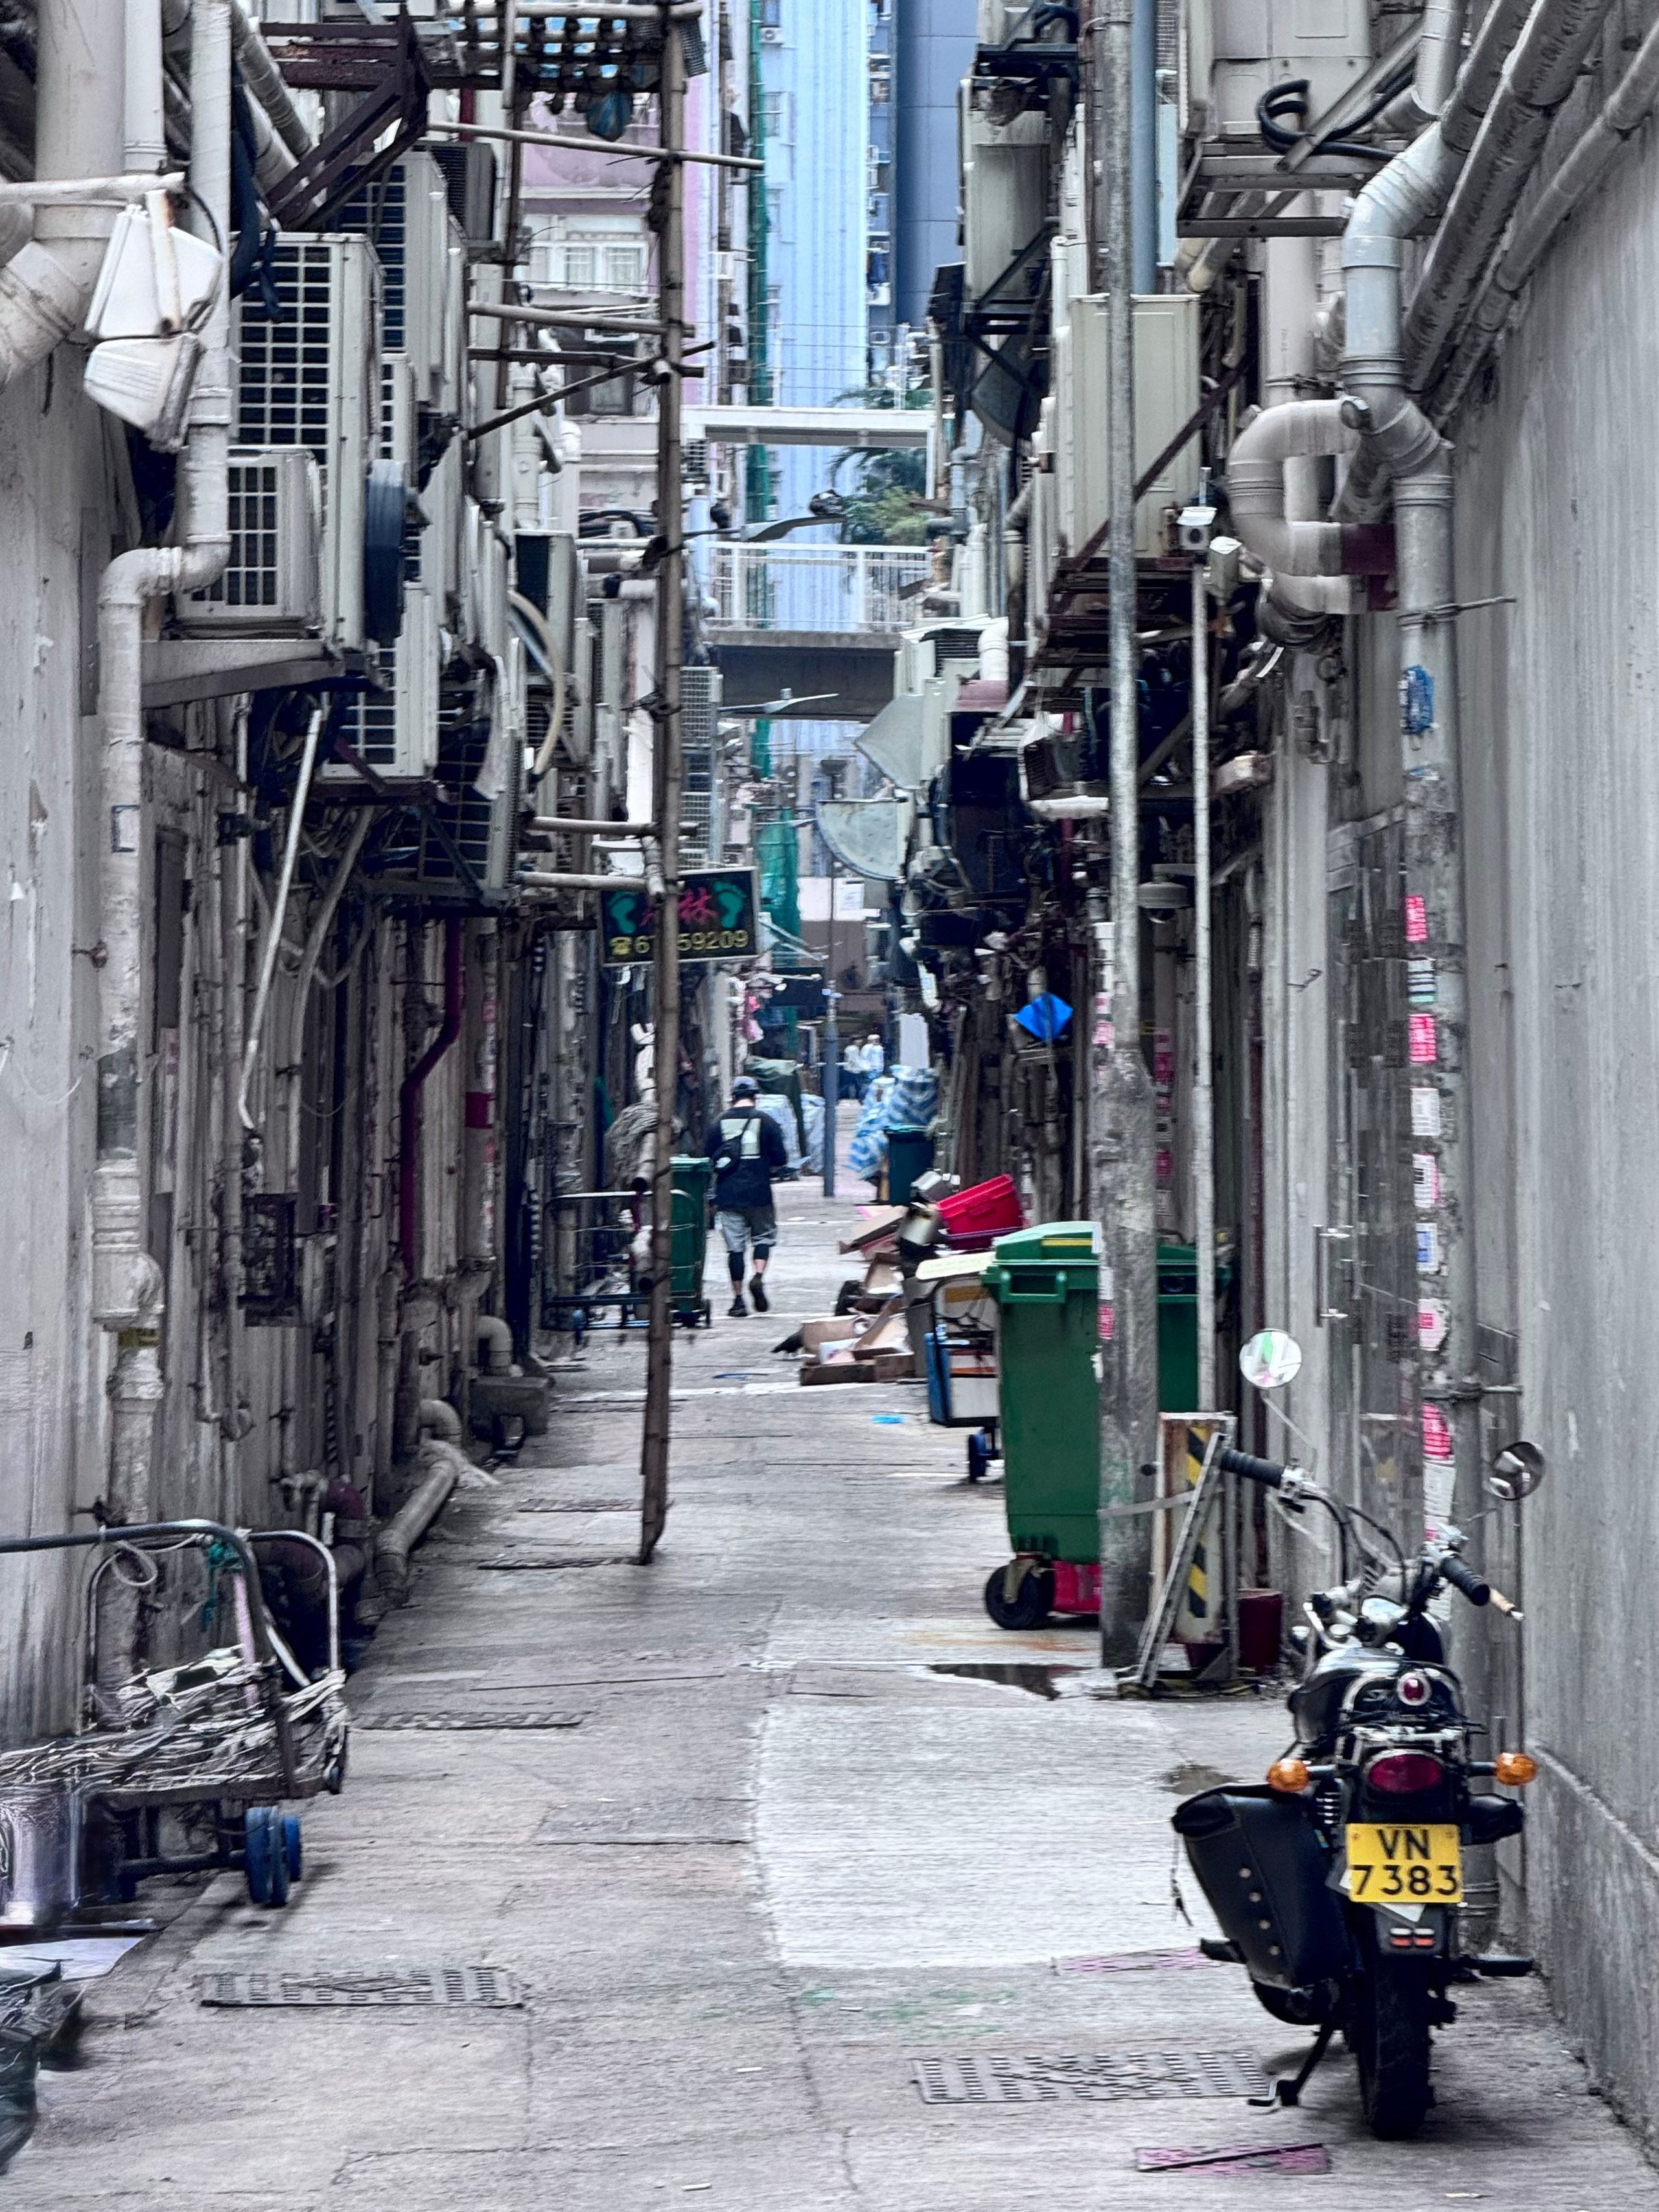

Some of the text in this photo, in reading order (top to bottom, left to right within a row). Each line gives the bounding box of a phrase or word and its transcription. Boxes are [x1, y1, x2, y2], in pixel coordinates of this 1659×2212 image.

[634, 929, 748, 954] 659209
[1376, 1828, 1432, 1861] VN
[1351, 1865, 1459, 1896] 7383
